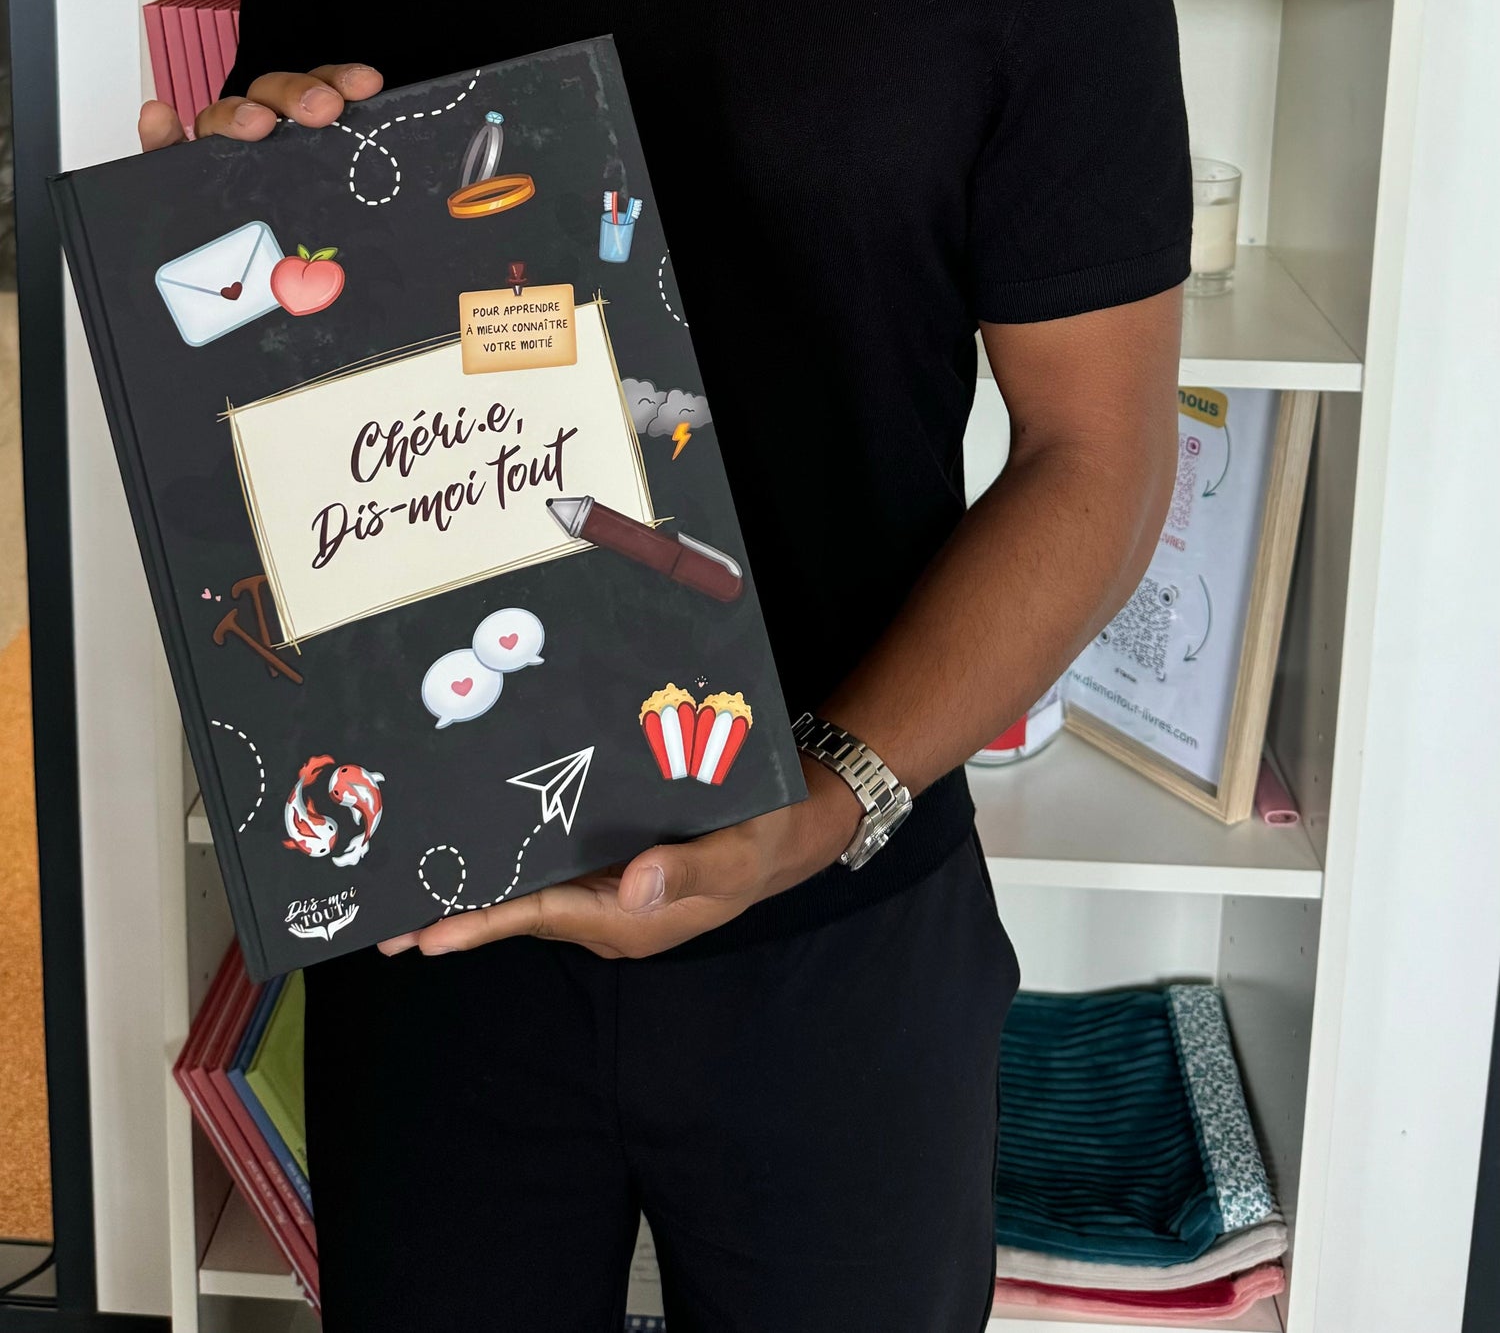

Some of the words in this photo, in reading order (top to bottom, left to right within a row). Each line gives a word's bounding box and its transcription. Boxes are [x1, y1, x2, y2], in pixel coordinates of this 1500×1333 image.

[473, 306, 499, 317] POUR
[503, 302, 560, 315] APPRENDRE
[466, 324, 473, 335] À
[477, 324, 508, 335] MIEUX
[512, 319, 568, 332] CONNAÎTRE
[483, 341, 516, 352] VOTRE
[521, 336, 553, 350] MOITIÉ
[311, 470, 487, 569] Dis-moi
[485, 427, 579, 510] tout
[300, 901, 345, 927] TOUT
